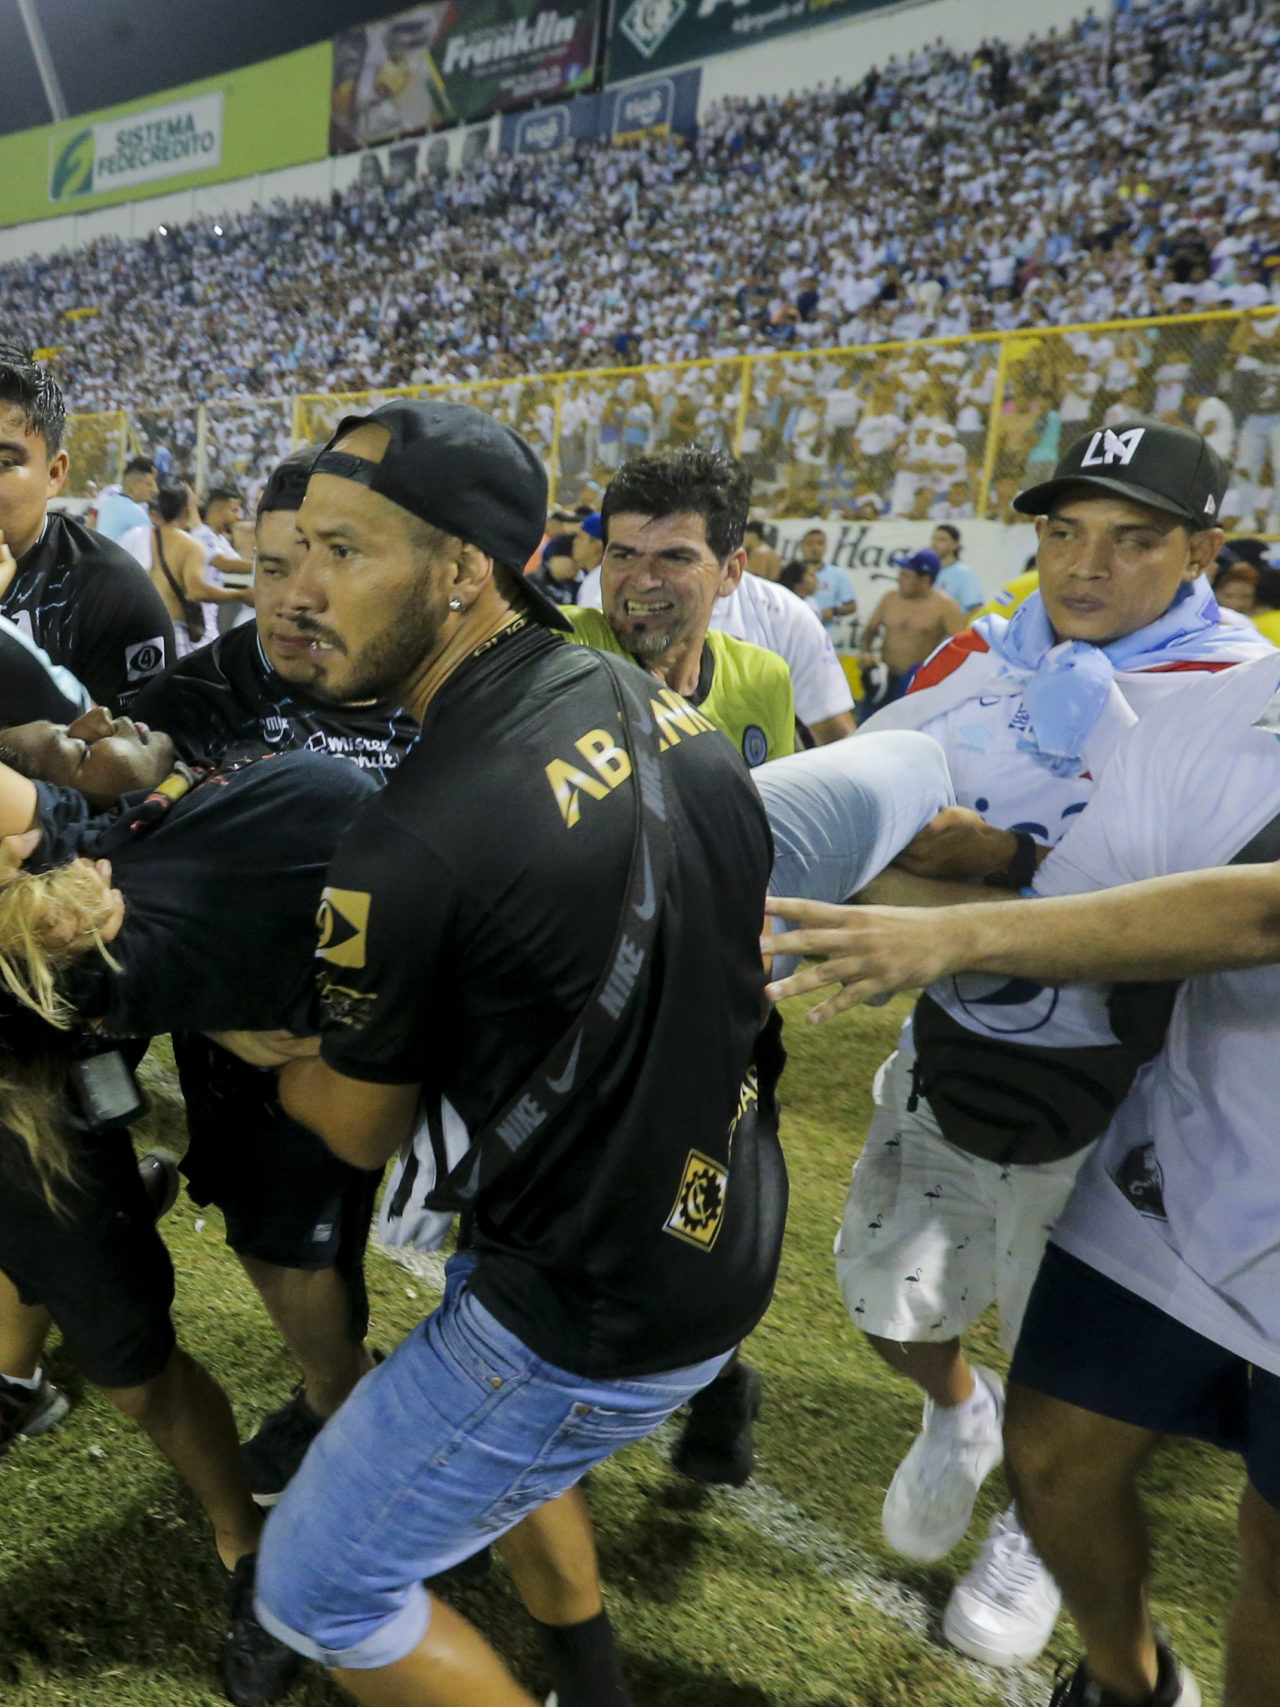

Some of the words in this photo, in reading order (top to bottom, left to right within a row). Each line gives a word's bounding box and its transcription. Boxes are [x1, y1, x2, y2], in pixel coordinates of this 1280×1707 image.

[442, 10, 576, 74] Franklin
[117, 112, 195, 146] SISTEMA
[545, 689, 717, 829] ABNK
[598, 933, 645, 1021] NIKE
[496, 1092, 548, 1153] NIKE
